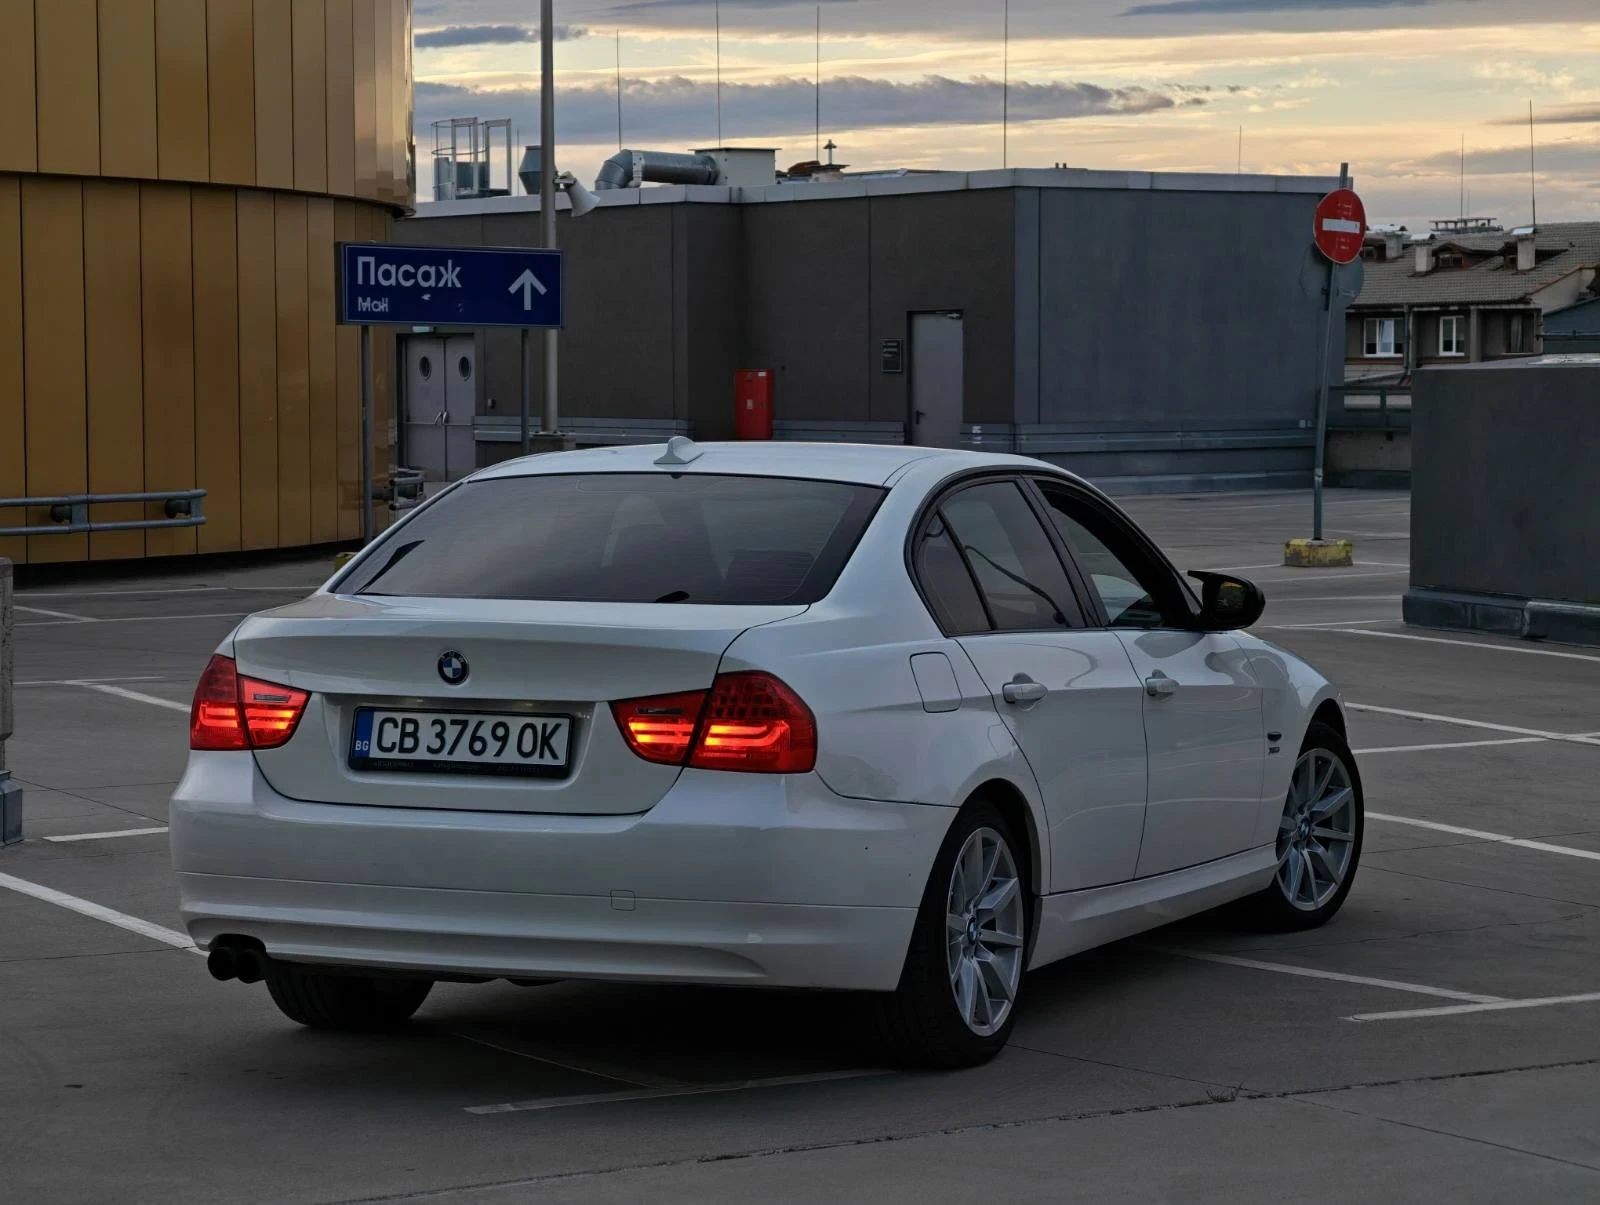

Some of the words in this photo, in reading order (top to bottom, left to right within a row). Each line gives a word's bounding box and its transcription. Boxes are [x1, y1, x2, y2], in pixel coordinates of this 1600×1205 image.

[357, 256, 462, 288] Пасаж
[355, 740, 369, 751] BG
[376, 717, 420, 754] CB
[426, 718, 510, 757] 3769
[516, 722, 562, 760] OK
